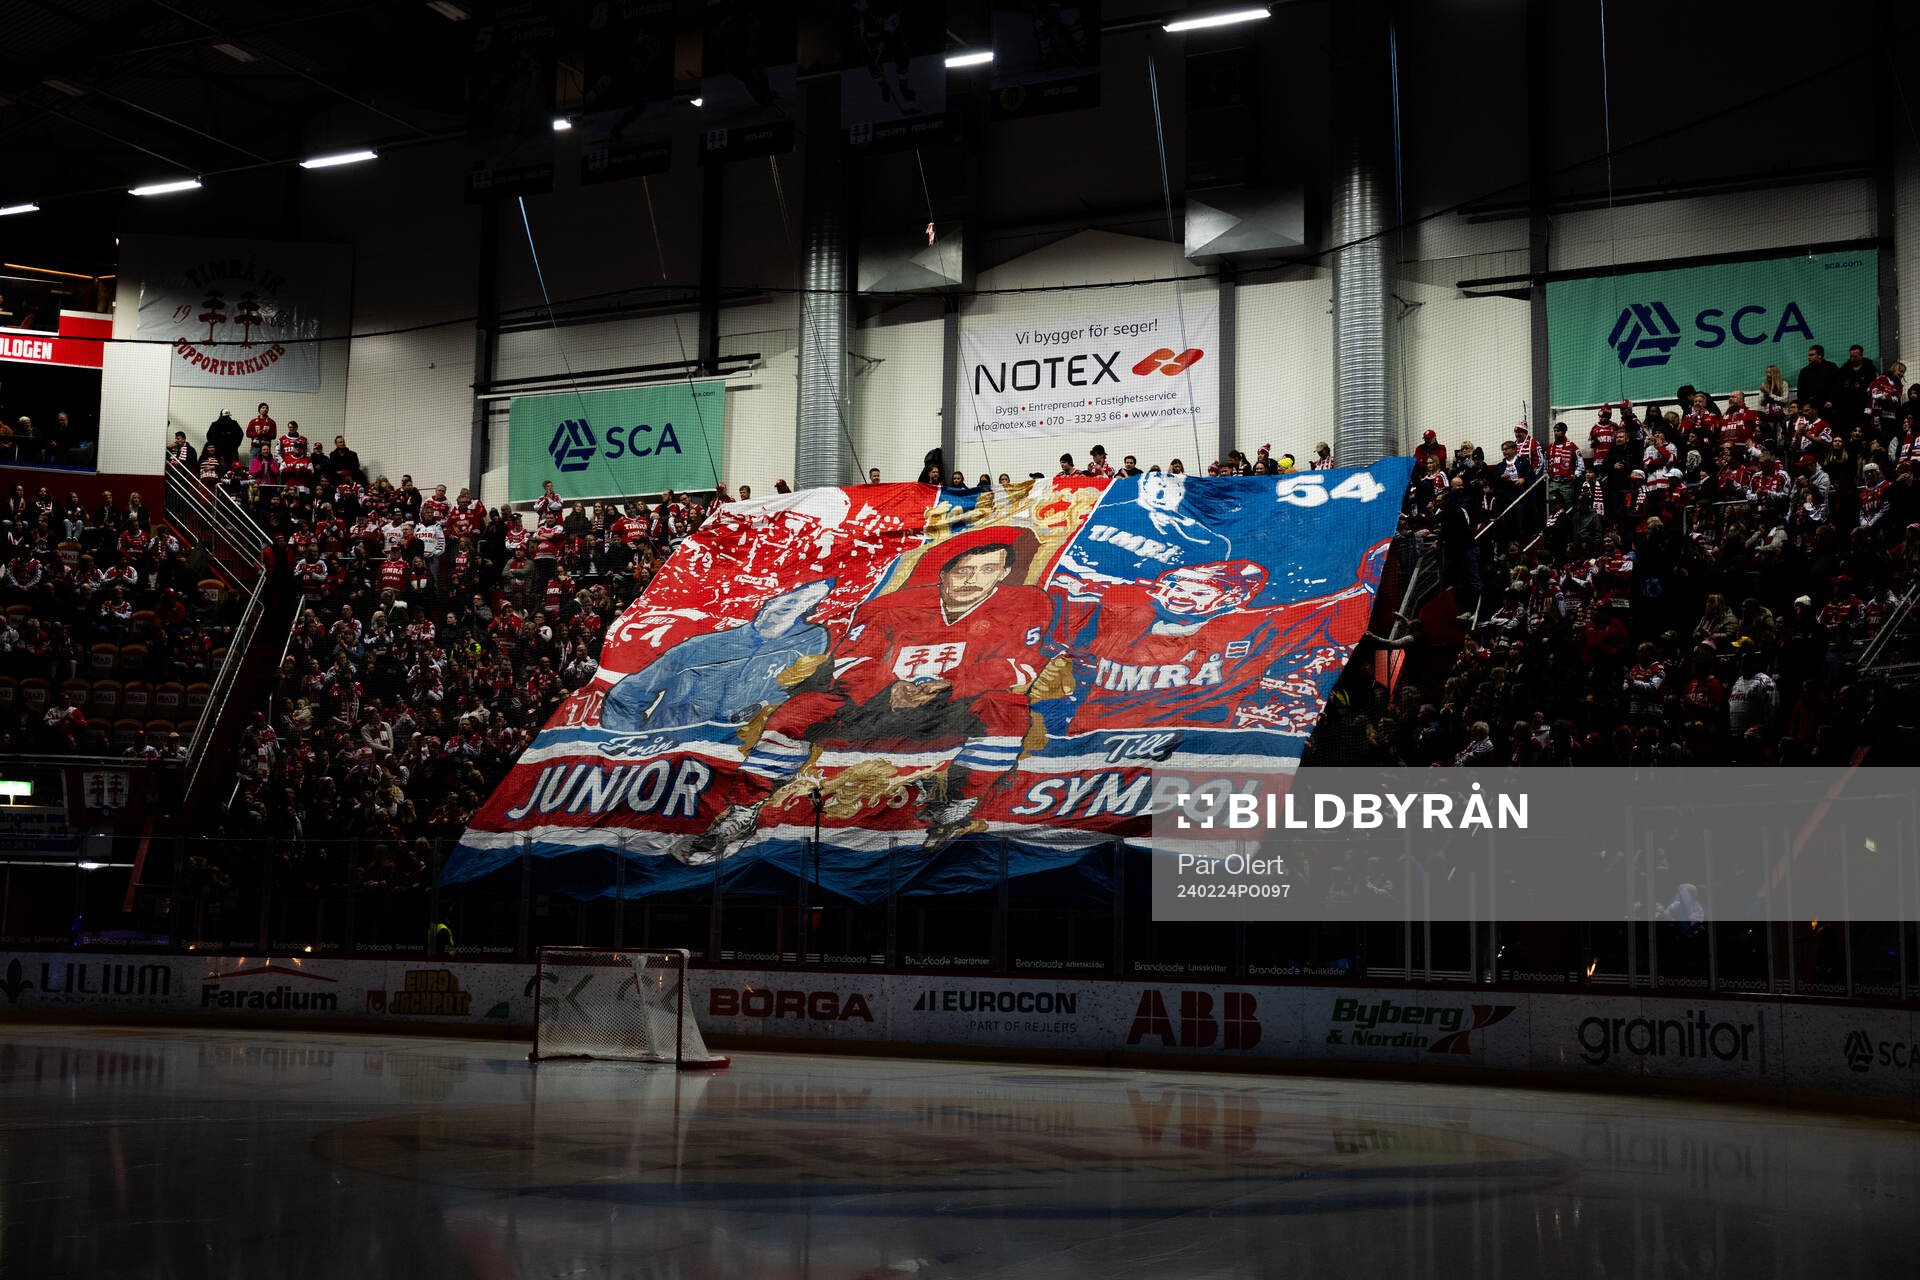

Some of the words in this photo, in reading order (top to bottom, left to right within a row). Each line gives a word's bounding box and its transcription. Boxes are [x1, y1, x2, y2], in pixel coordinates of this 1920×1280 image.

[1015, 332, 1030, 345] Vi
[1034, 328, 1084, 346] bygger
[1089, 324, 1109, 338] för
[1113, 318, 1158, 338] seger!
[1694, 302, 1814, 348] SCA
[172, 337, 286, 375] SUPPORTERKLUBB
[975, 351, 1121, 395] NOTEX
[974, 419, 1037, 432] info@notex.se
[1046, 416, 1064, 426] 070
[1074, 414, 1093, 424] 332
[1095, 412, 1107, 423] 93
[1109, 411, 1121, 421] 66
[1132, 406, 1201, 419] www.notex.se
[995, 405, 1019, 416] Bygg
[1028, 398, 1085, 413] Entreprenad
[1095, 391, 1177, 407] Fastighetsservice
[605, 423, 682, 459] SCA
[1276, 472, 1386, 507] 54
[1025, 626, 1042, 647] 5
[1095, 652, 1225, 692] TIMRÅ
[599, 734, 679, 756] Från
[1104, 732, 1178, 763] Till
[506, 757, 712, 819] JUNIOR
[1012, 772, 1259, 828] SYMBOL
[41, 963, 171, 995] LILIUM
[201, 983, 337, 1010] Faradium
[709, 988, 874, 1022] BORGA
[943, 990, 1077, 1014] EUROCON
[970, 1021, 999, 1032] PART
[1004, 1021, 1019, 1032] OF
[1024, 1022, 1077, 1033] REJLERS
[1126, 989, 1261, 1050] ABB
[1332, 998, 1464, 1032] Byberg
[1326, 1030, 1344, 1045] &
[1351, 1029, 1428, 1048] Nordin
[1578, 1010, 1754, 1065] granitor
[1878, 1041, 1920, 1068] SCA
